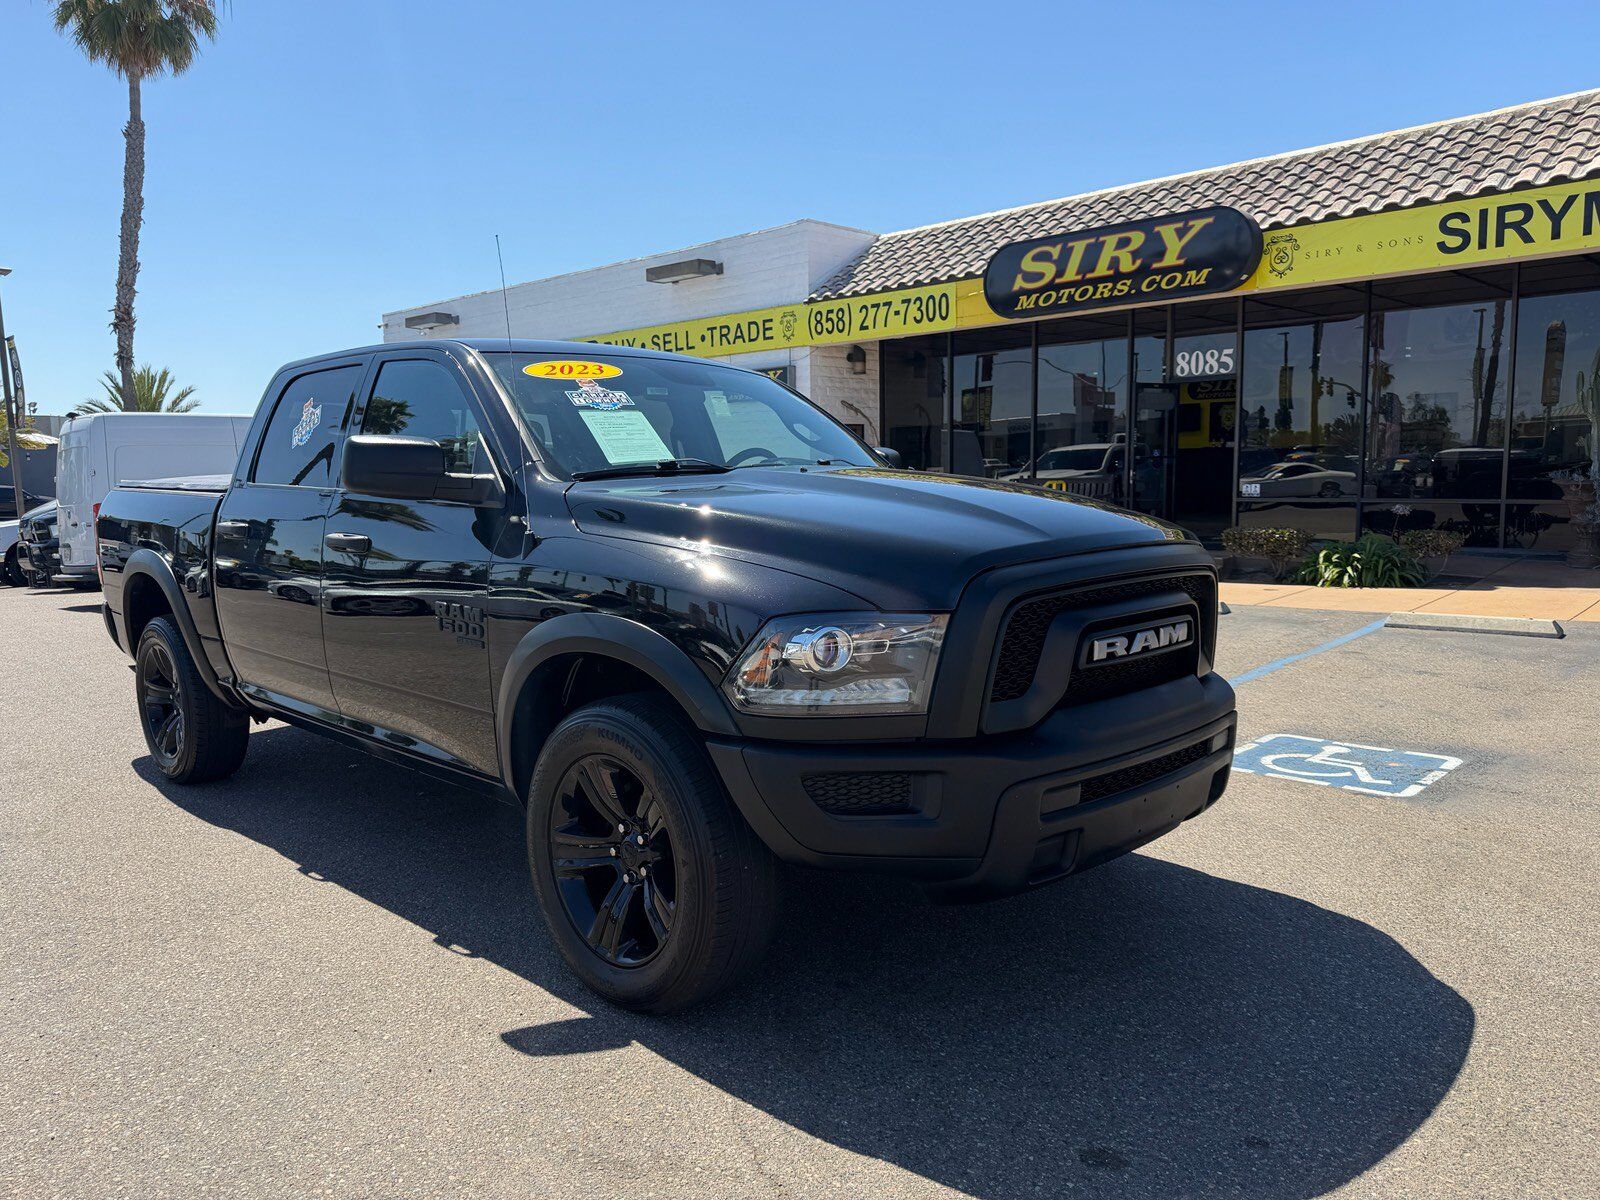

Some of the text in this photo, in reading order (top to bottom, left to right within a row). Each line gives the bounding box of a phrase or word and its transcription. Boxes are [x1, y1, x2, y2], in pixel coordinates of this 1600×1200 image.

[1012, 216, 1216, 292] SIRY
[1304, 234, 1425, 261] SIRY & SONS
[1013, 268, 1212, 311] MOTORS.COM
[807, 292, 951, 340] (858) 277-7300
[650, 329, 696, 353] SELL
[706, 317, 774, 347] TRADE
[543, 364, 604, 376] 2023
[1176, 347, 1235, 378] 8085
[434, 600, 484, 623] RAM
[1093, 621, 1188, 661] RAM
[597, 727, 644, 761] KUMHO
